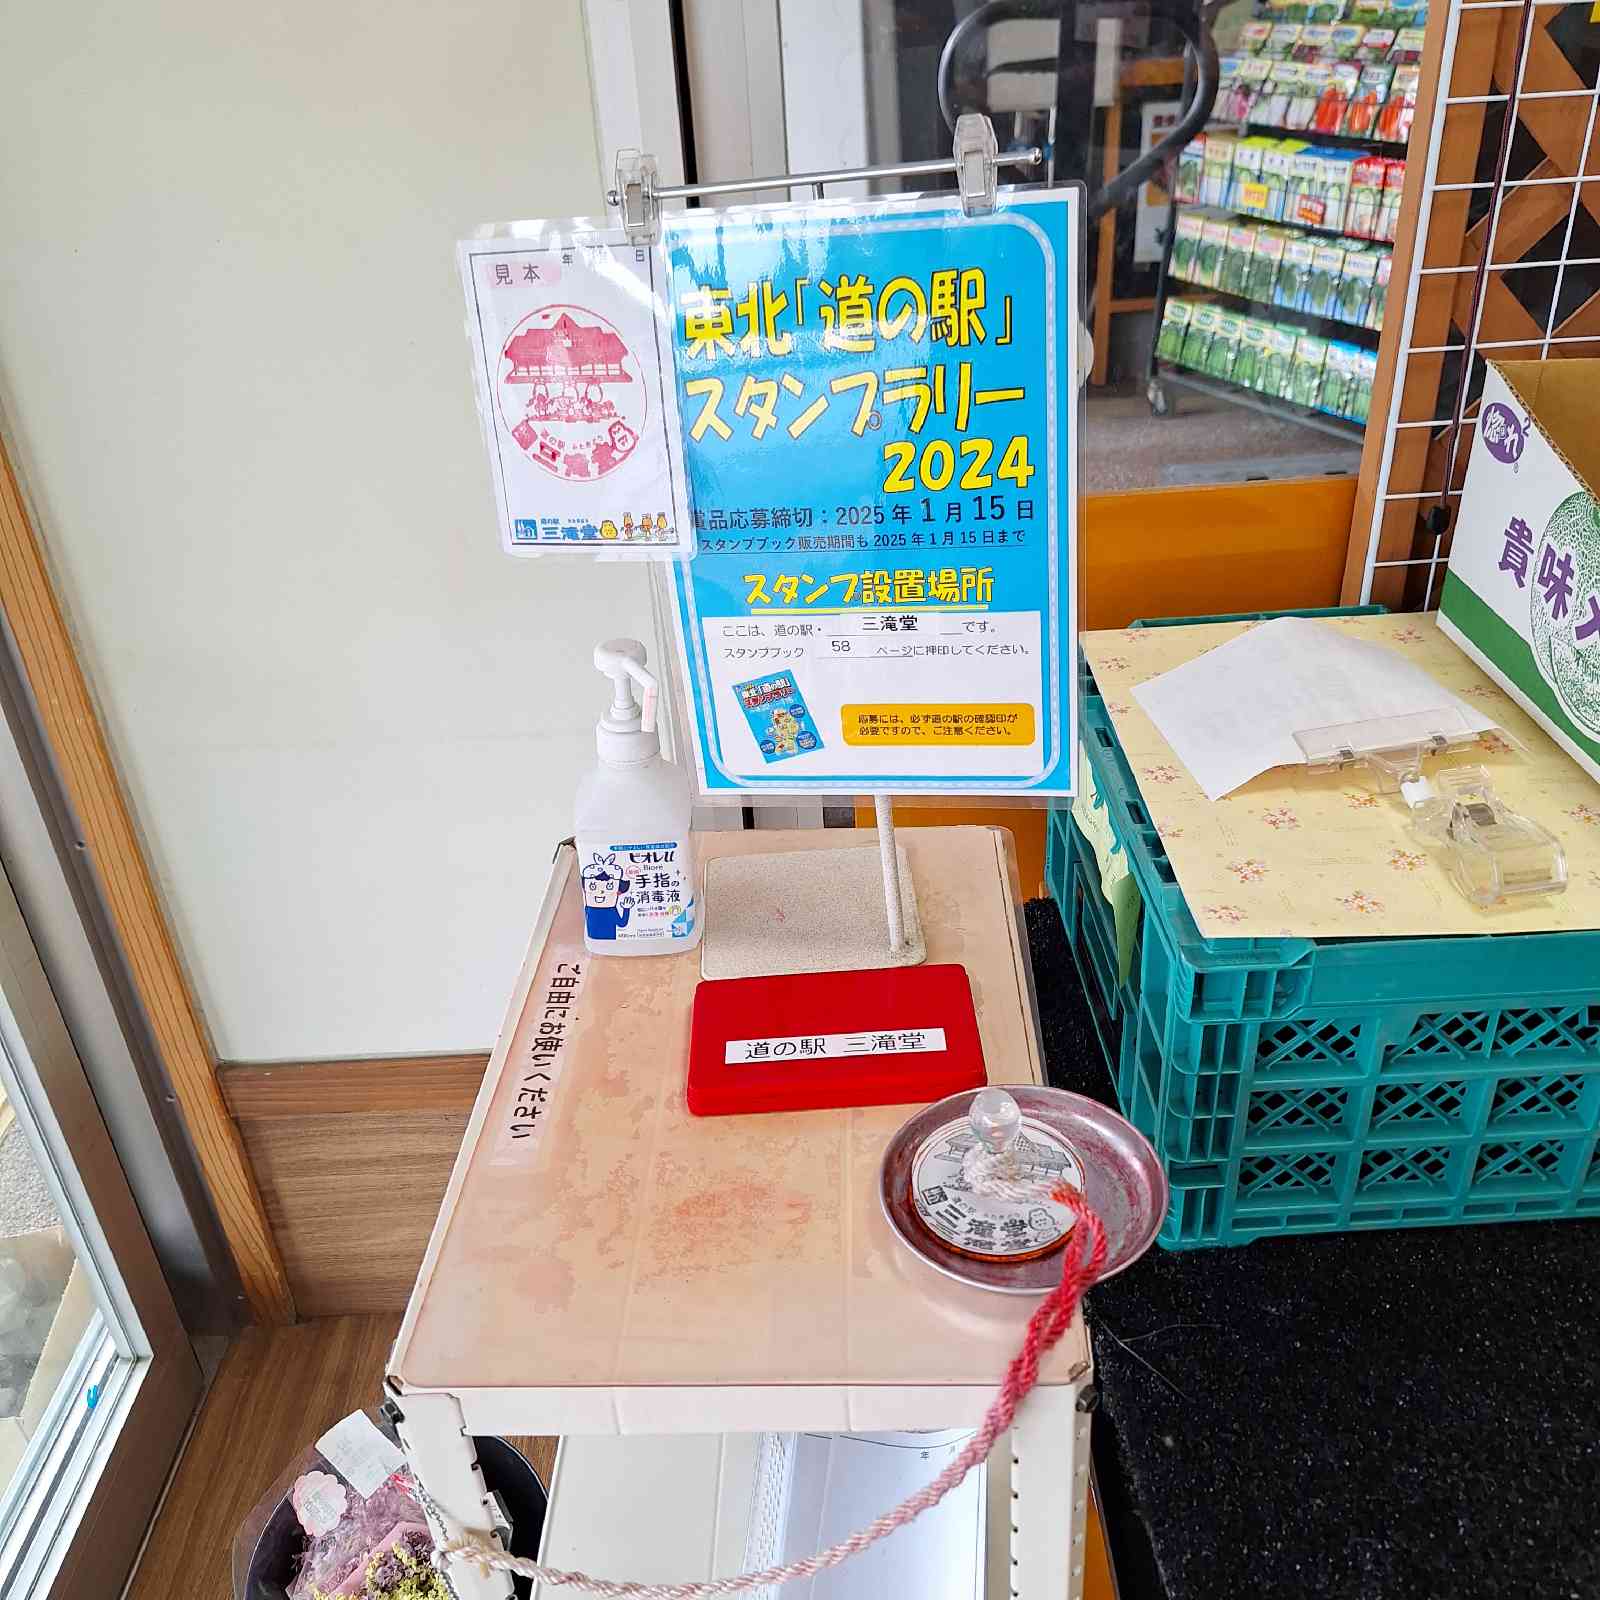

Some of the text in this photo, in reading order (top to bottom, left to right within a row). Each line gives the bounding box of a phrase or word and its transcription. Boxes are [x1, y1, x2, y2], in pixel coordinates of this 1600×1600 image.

[681, 266, 1013, 361] 東北「道の駅」
[686, 361, 1025, 442] スタンプラリー
[882, 436, 1035, 494] 2024
[743, 567, 996, 604] スタンプ設置場所
[862, 615, 918, 632] 三滝堂
[831, 640, 850, 652] 58
[635, 873, 680, 889] 手指の
[636, 890, 680, 905] 消毒液
[510, 964, 581, 1139] ご自由にお使いください
[745, 1032, 926, 1059] 道の駅 三滝堂
